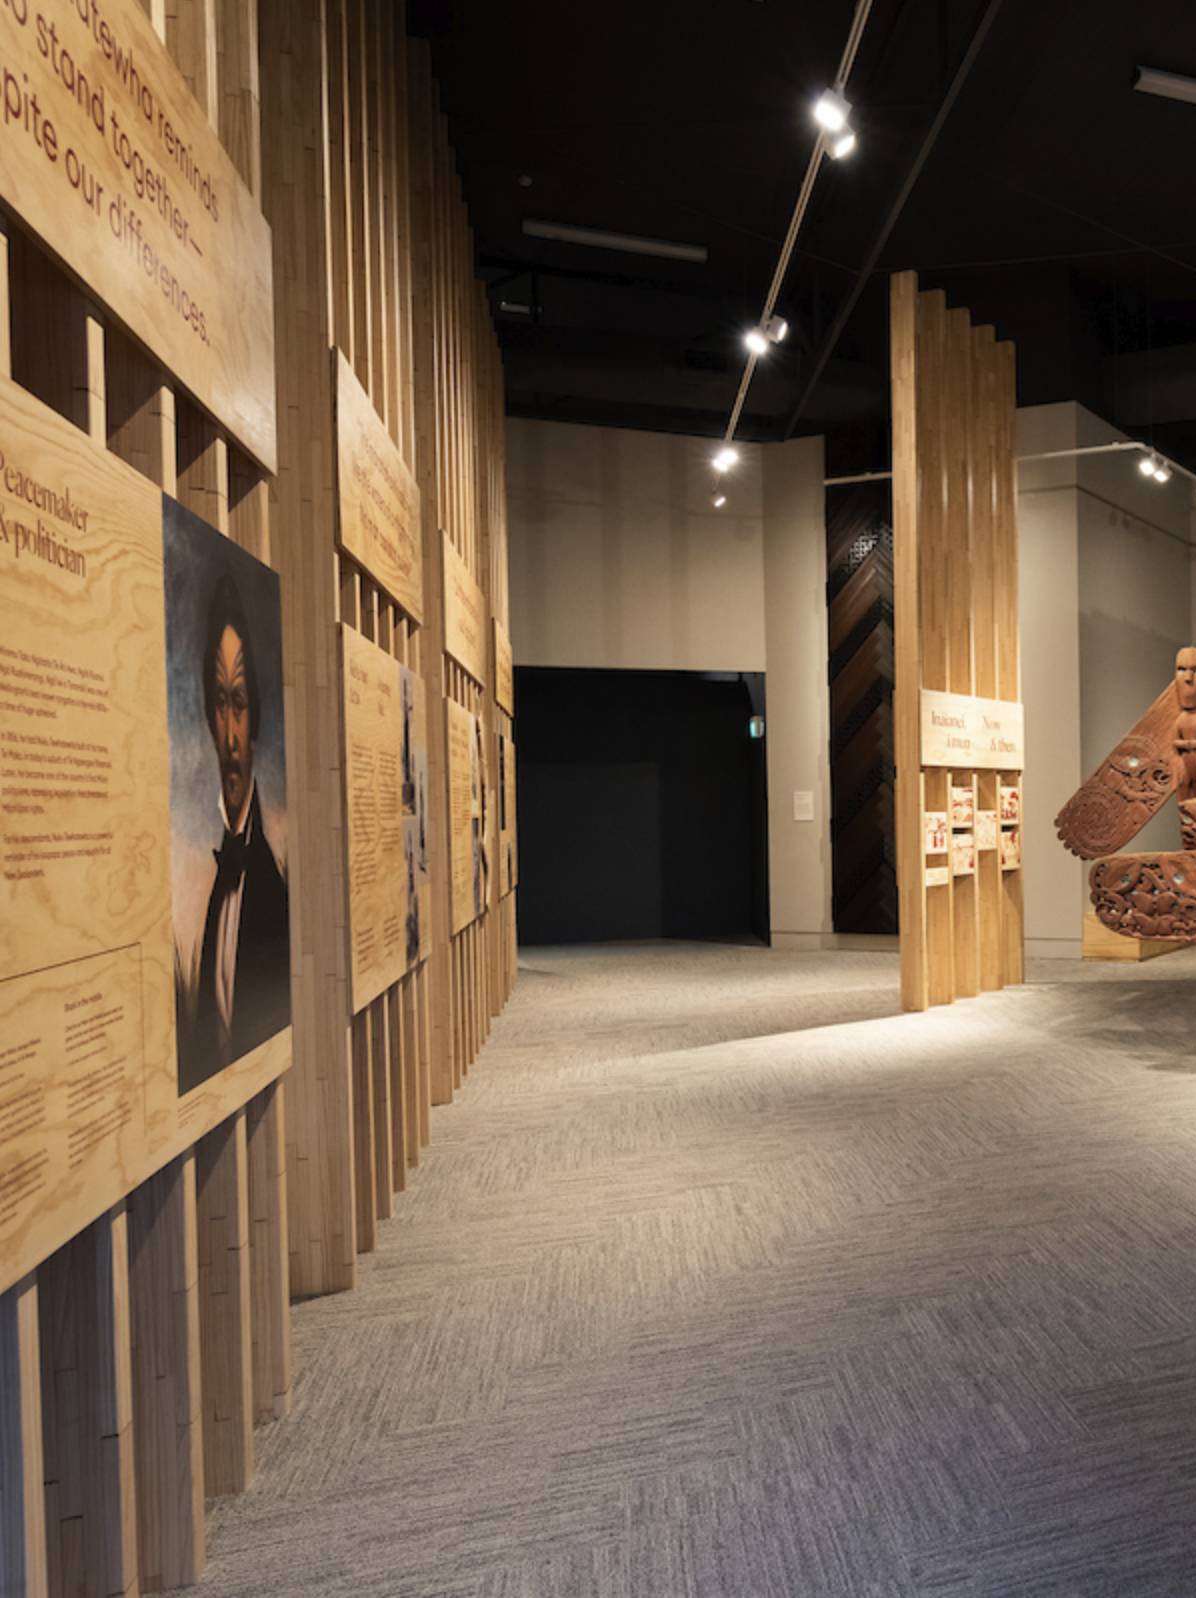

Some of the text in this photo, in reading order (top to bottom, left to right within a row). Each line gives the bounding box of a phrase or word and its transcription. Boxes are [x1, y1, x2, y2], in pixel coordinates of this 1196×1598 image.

[36, 13, 105, 132] stand
[0, 66, 212, 347] pite our differences.
[157, 112, 220, 223] reminds
[0, 451, 89, 533] eacemaker
[14, 519, 87, 578] politician
